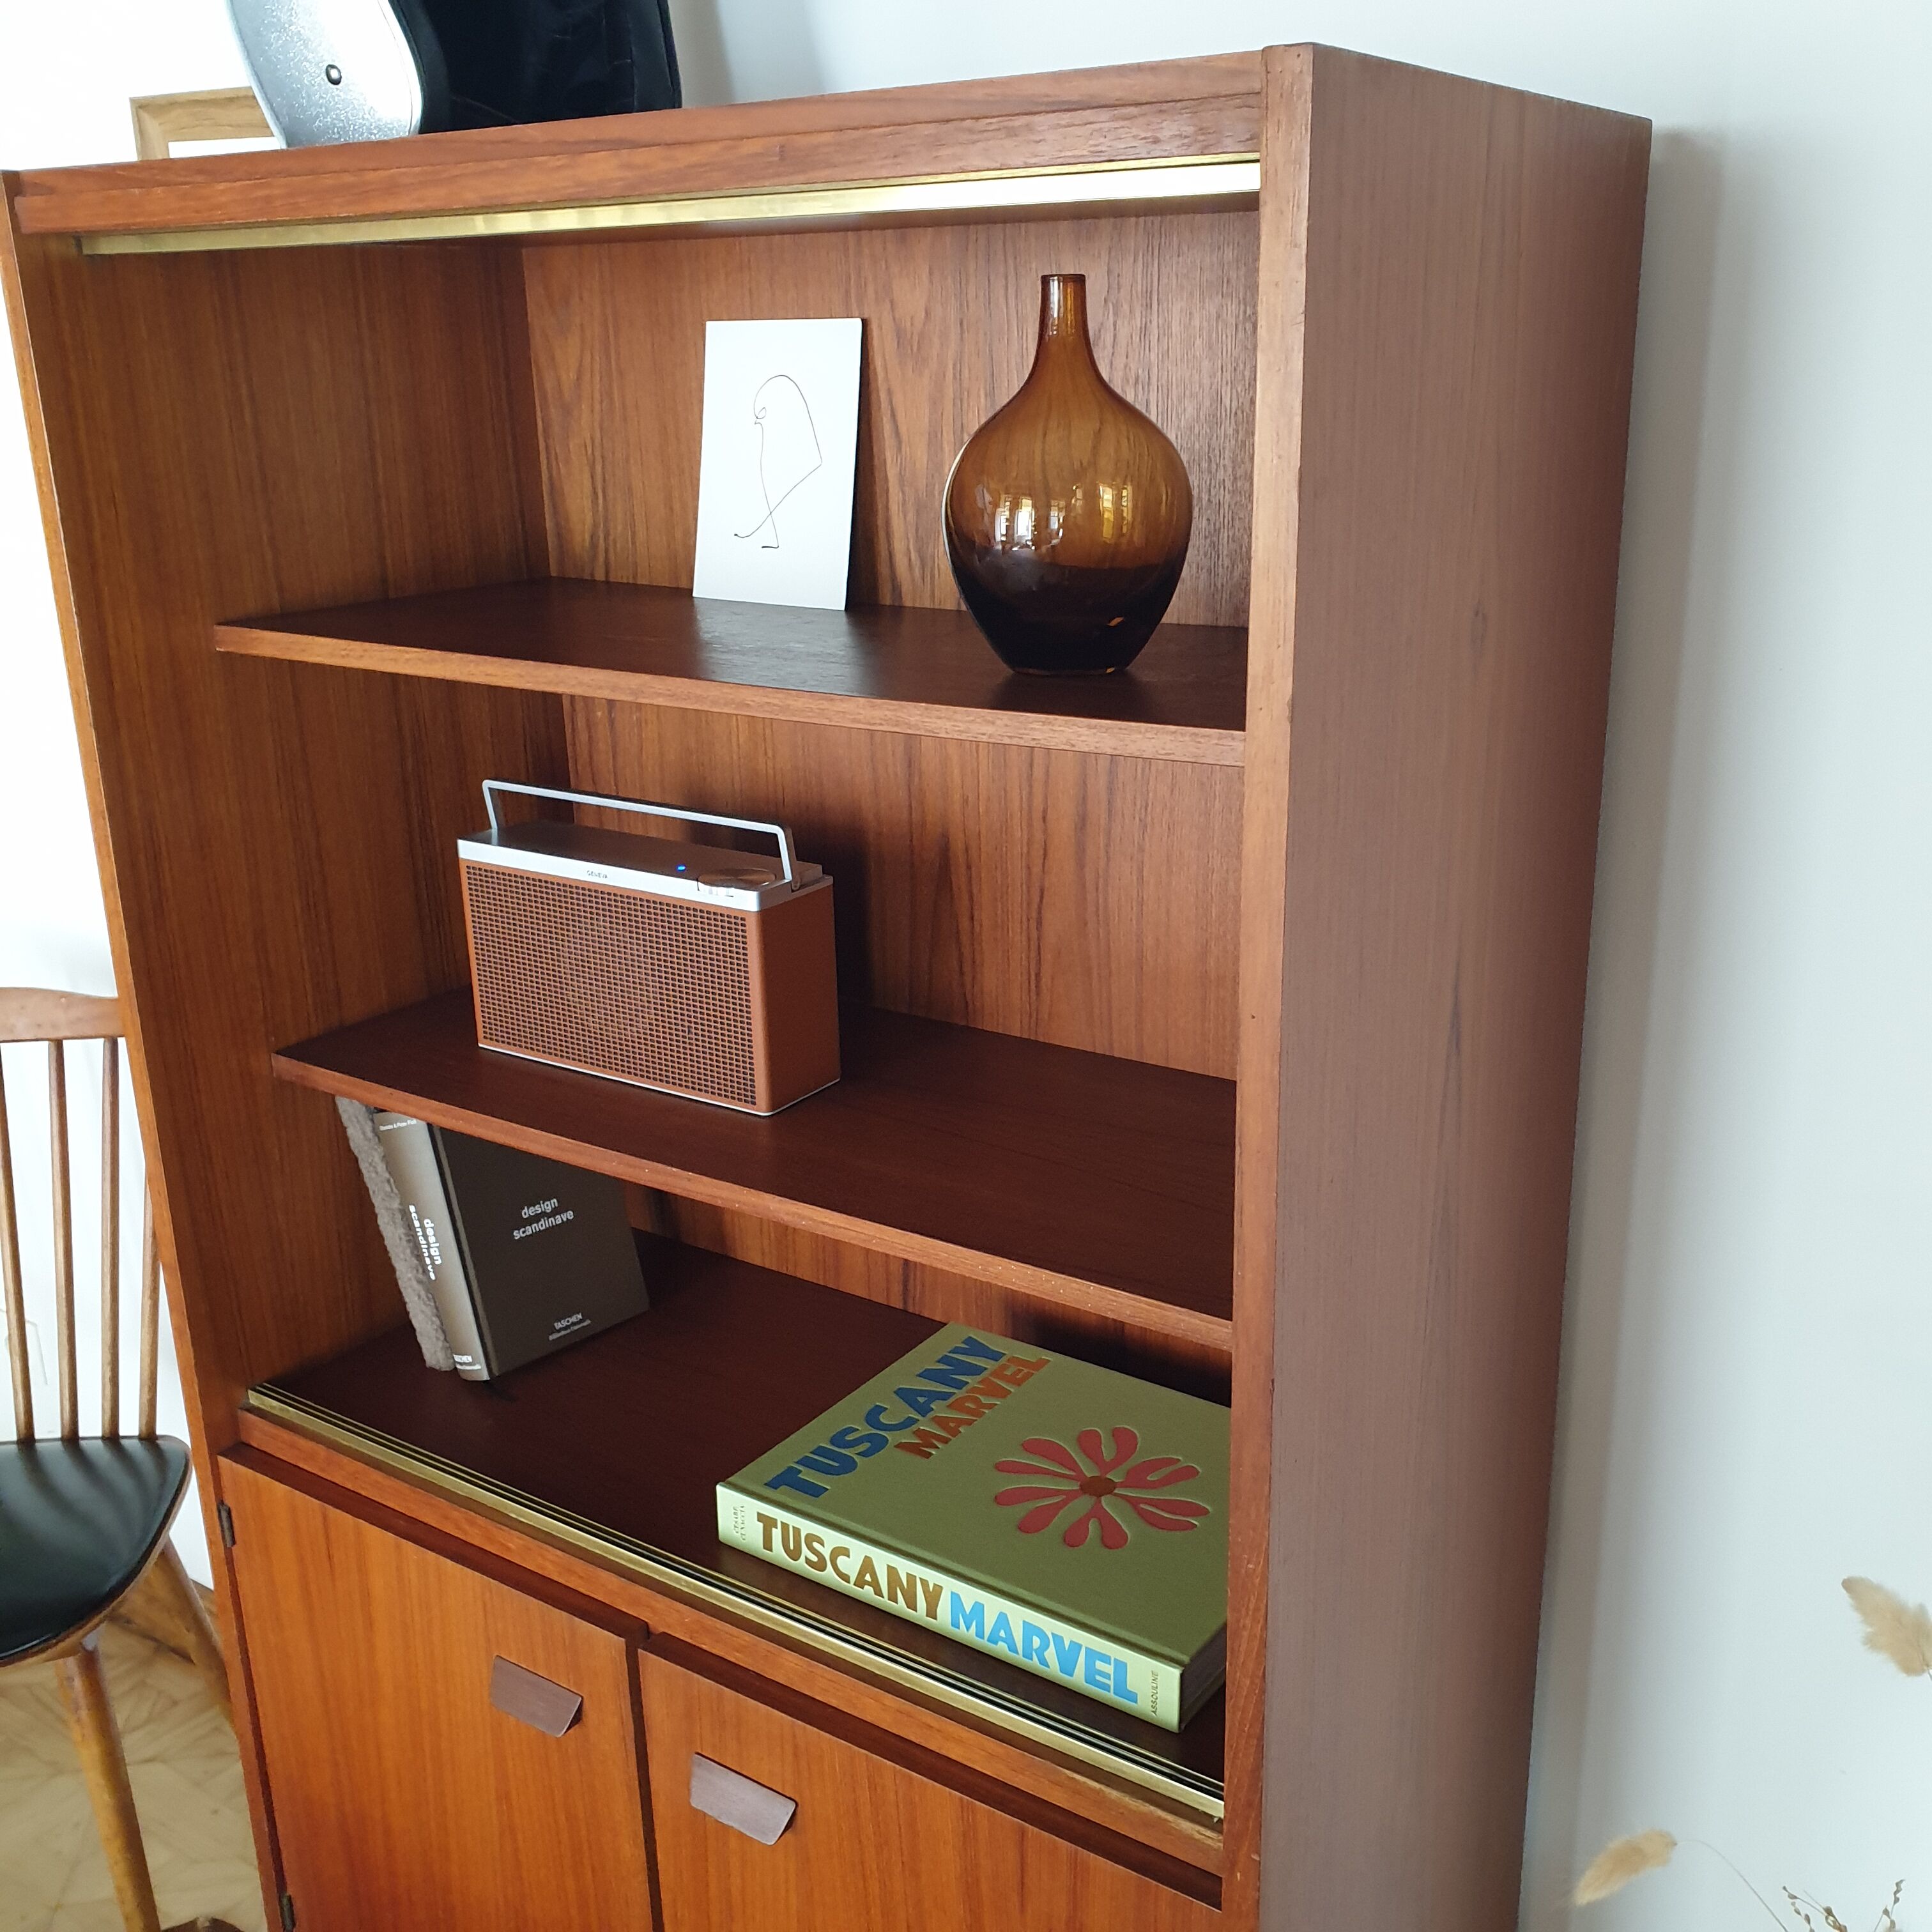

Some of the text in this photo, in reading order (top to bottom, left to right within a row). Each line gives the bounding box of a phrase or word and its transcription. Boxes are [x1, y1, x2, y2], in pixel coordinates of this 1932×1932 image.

[513, 1210, 574, 1240] scandinave
[521, 1198, 558, 1218] design
[409, 1204, 436, 1280] scandinave
[424, 1218, 441, 1265] design
[763, 1335, 1007, 1498] TUSCANY
[894, 1356, 1052, 1460] MARVEL
[756, 1511, 1138, 1705] TUSCANY MARVEL
[1151, 1670, 1159, 1717] ASSOULINE
